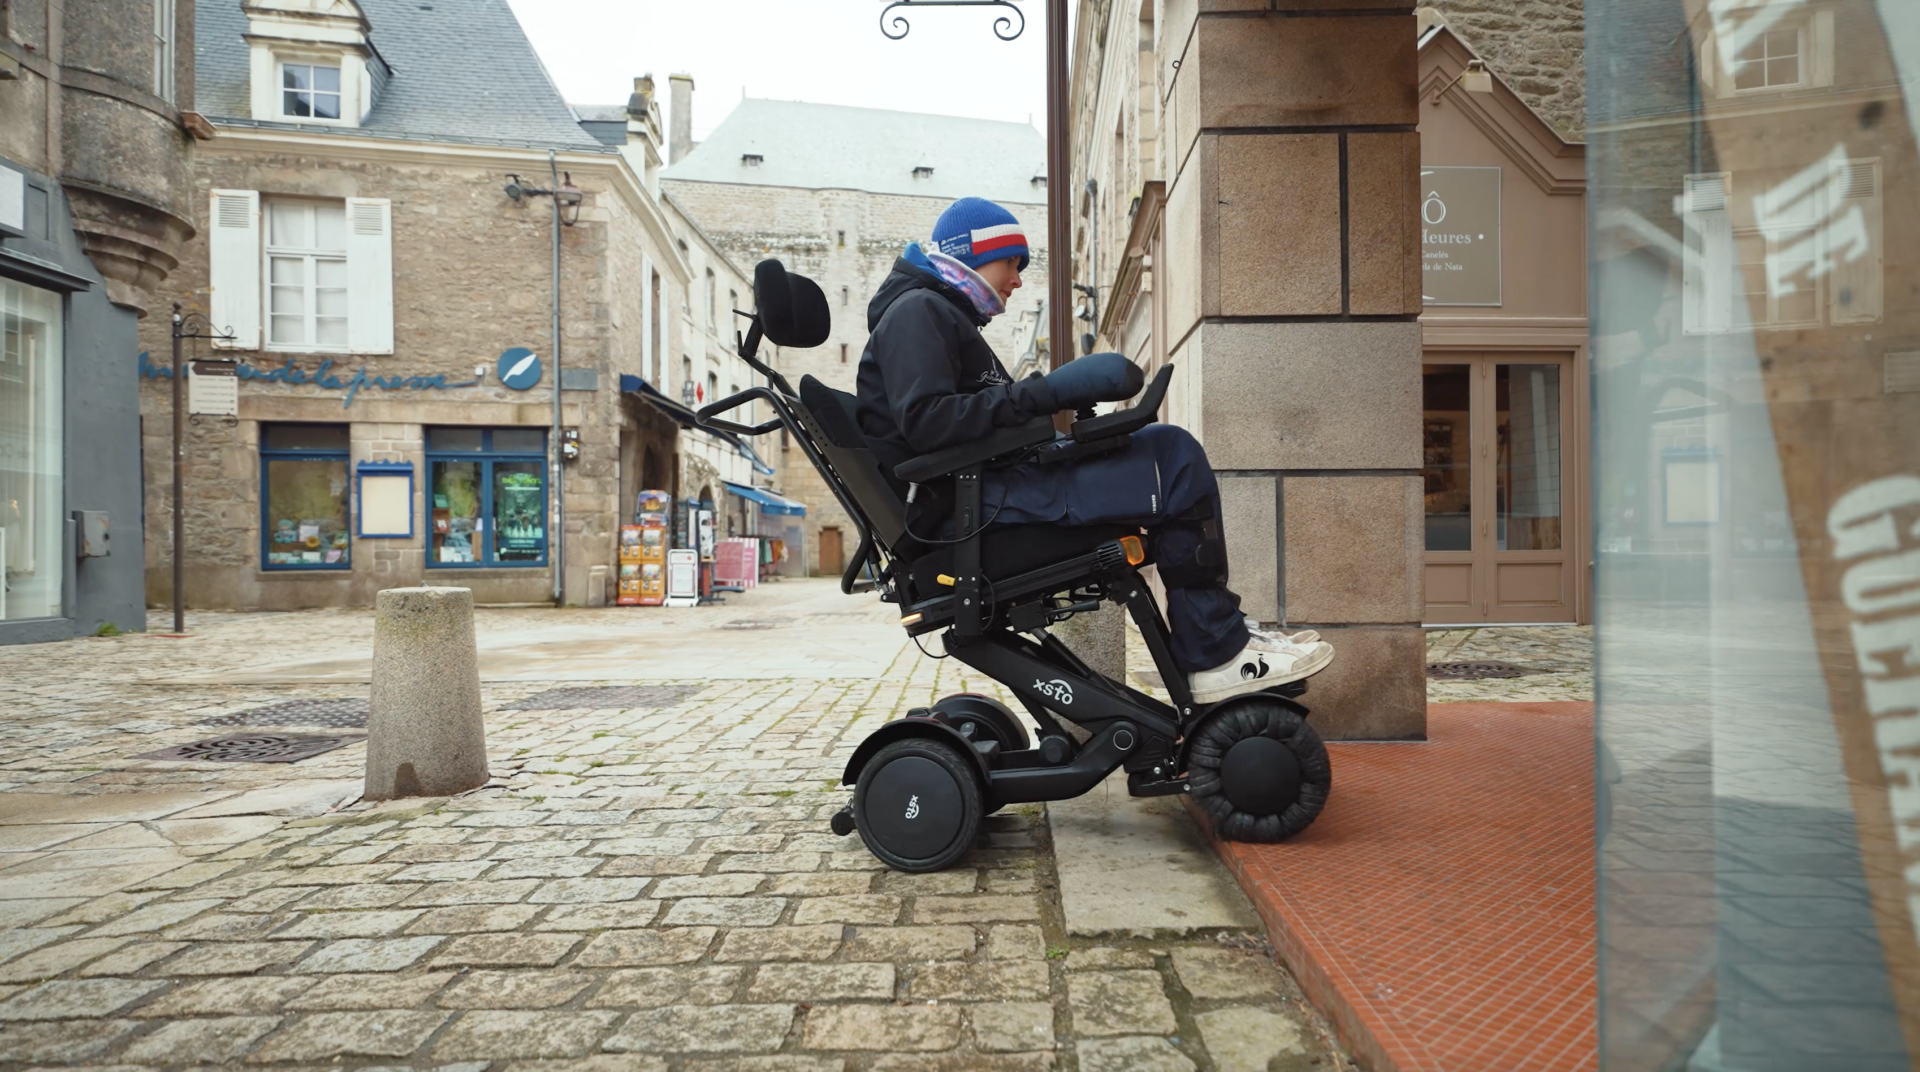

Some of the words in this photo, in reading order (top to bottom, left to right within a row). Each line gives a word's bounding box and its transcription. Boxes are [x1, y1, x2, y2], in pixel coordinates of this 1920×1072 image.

[1432, 262, 1442, 270] de
[1445, 262, 1463, 270] Nata
[1032, 678, 1074, 705] xsto
[904, 794, 919, 819] xsto
